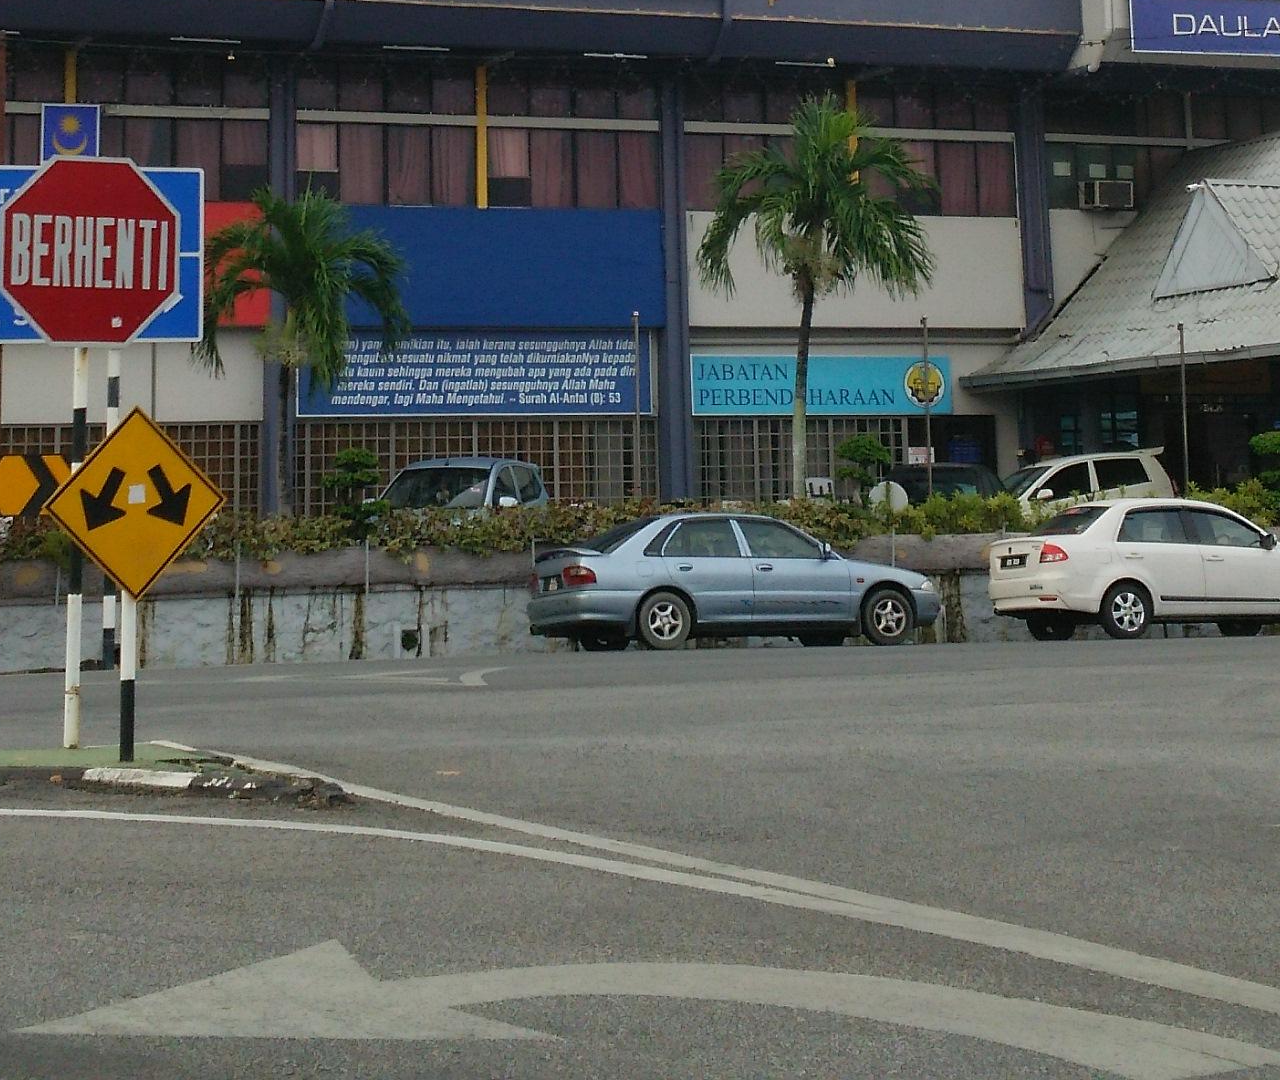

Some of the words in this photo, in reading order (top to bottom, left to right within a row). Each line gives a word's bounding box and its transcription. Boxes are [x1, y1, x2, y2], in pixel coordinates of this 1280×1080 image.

[10, 212, 169, 291] BERHENTI
[518, 339, 586, 352] sesungguhnya
[589, 339, 613, 350] Allah
[437, 353, 471, 363] nikmat
[474, 354, 497, 365] yang
[500, 353, 524, 363] telah
[603, 353, 636, 365] kepada
[357, 366, 385, 377] kaum
[387, 366, 433, 379] sehingga
[435, 366, 471, 377] mereka
[475, 366, 525, 379] mengubah
[528, 367, 545, 379] apa
[548, 367, 571, 379] yang
[574, 366, 591, 377] ada
[594, 366, 617, 379] pada
[697, 363, 788, 381] JABATAN
[419, 380, 439, 391] Dan
[441, 379, 487, 393] (ingatlah)
[491, 380, 559, 393] sesungguhnya
[561, 380, 586, 391] Allah
[589, 380, 616, 391] Maha
[331, 393, 390, 406] mendengar,
[394, 393, 413, 406] lagi
[415, 393, 444, 405] Maha
[519, 392, 547, 404] Surah
[608, 392, 621, 403] 53
[699, 388, 896, 406] PERBENDHARAAN
